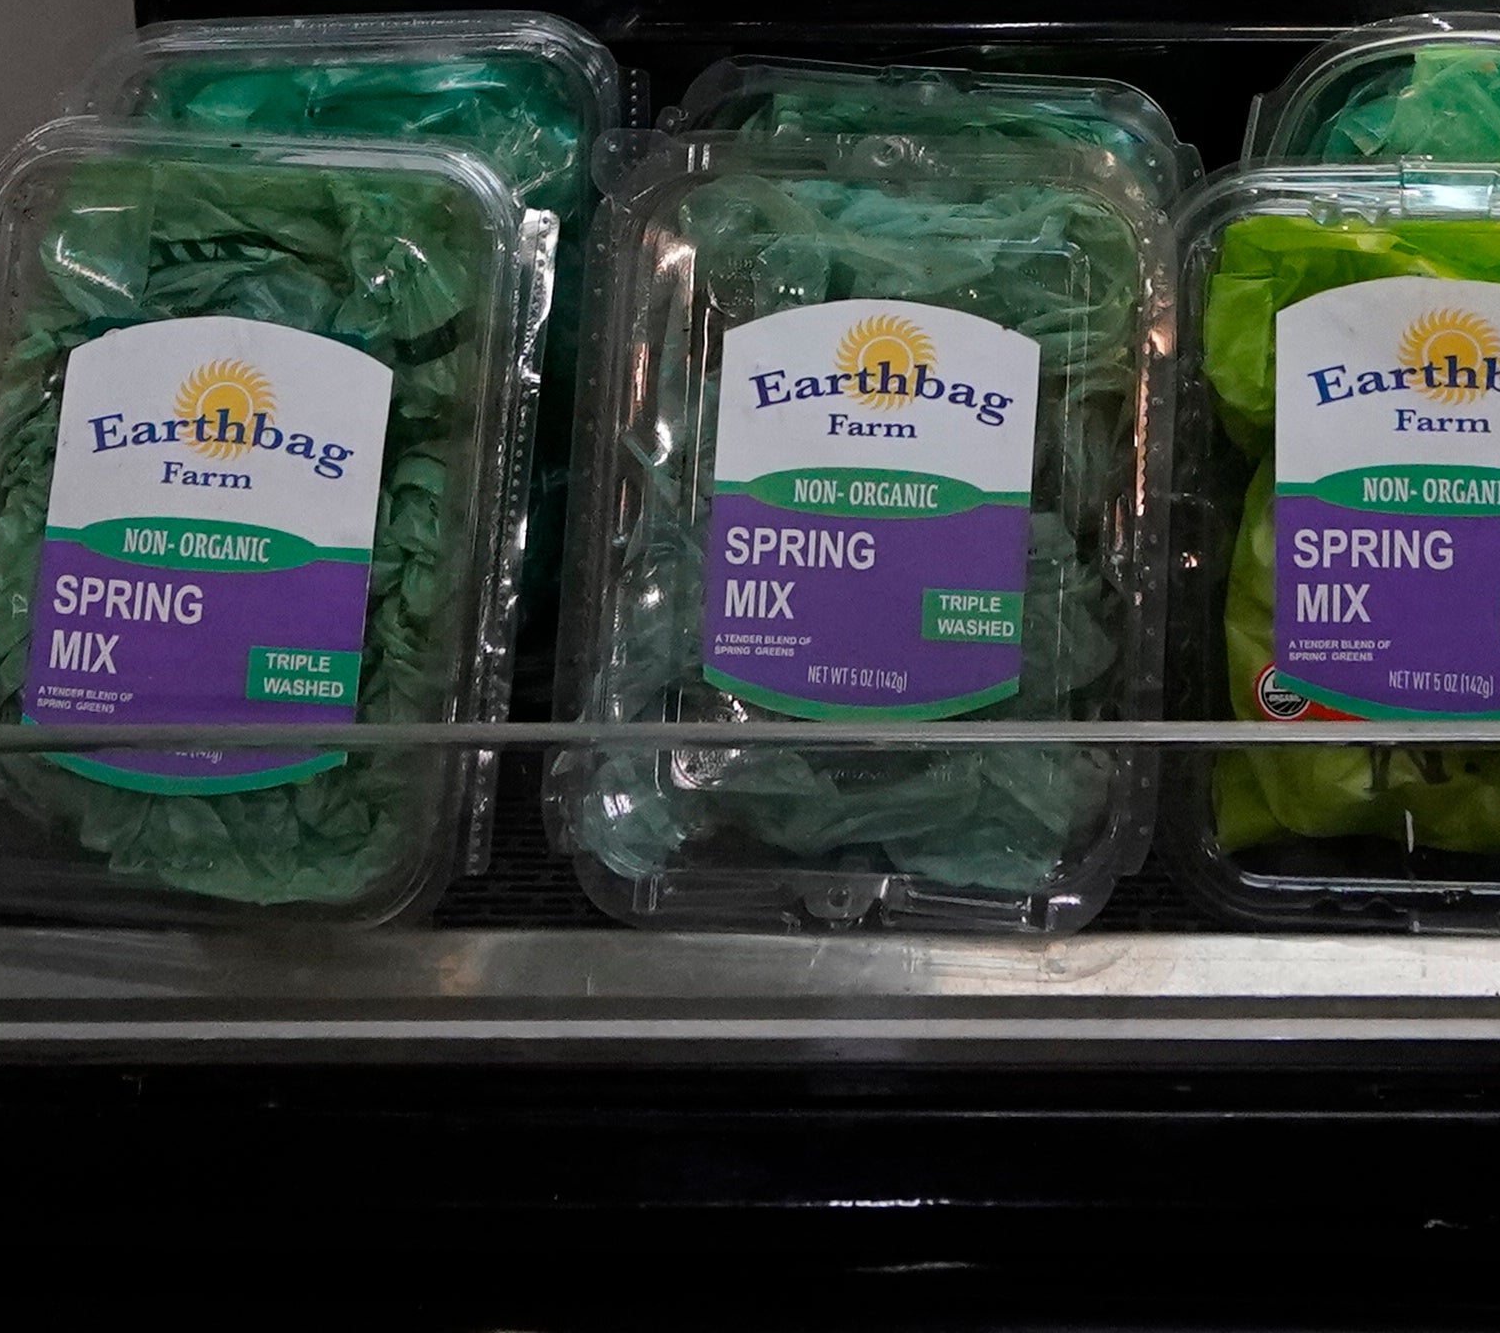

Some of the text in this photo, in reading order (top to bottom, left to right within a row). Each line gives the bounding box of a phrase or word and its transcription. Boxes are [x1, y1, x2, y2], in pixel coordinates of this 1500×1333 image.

[749, 361, 1014, 427] Earthbag
[827, 414, 918, 439] Farm
[1393, 409, 1491, 433] Farm
[87, 408, 354, 480] Earthbag
[161, 461, 252, 490] Farm
[849, 480, 938, 509] ORGANIC
[180, 531, 271, 563] ORGANIC
[725, 527, 876, 570] SPRING
[1293, 529, 1454, 571] SPRING
[53, 575, 203, 625] SPRING
[725, 580, 795, 620] MIX
[939, 595, 1002, 613] TRIPLE
[1296, 584, 1371, 623] MIX
[938, 618, 1015, 637] WASHED
[49, 630, 119, 675] MIX
[1288, 651, 1374, 662] SPRING GREENS
[1299, 640, 1338, 650] TENDER
[1341, 640, 1374, 650] BLEND
[265, 653, 331, 673] TRIPLE
[808, 666, 828, 683] NET
[830, 666, 848, 685] WT
[850, 668, 858, 685] 5
[860, 669, 874, 687] OZ
[263, 677, 344, 699] WASHED
[1389, 670, 1410, 688] NET
[1413, 671, 1430, 690] WT
[1433, 673, 1441, 690] 5
[1444, 673, 1457, 692] OZ
